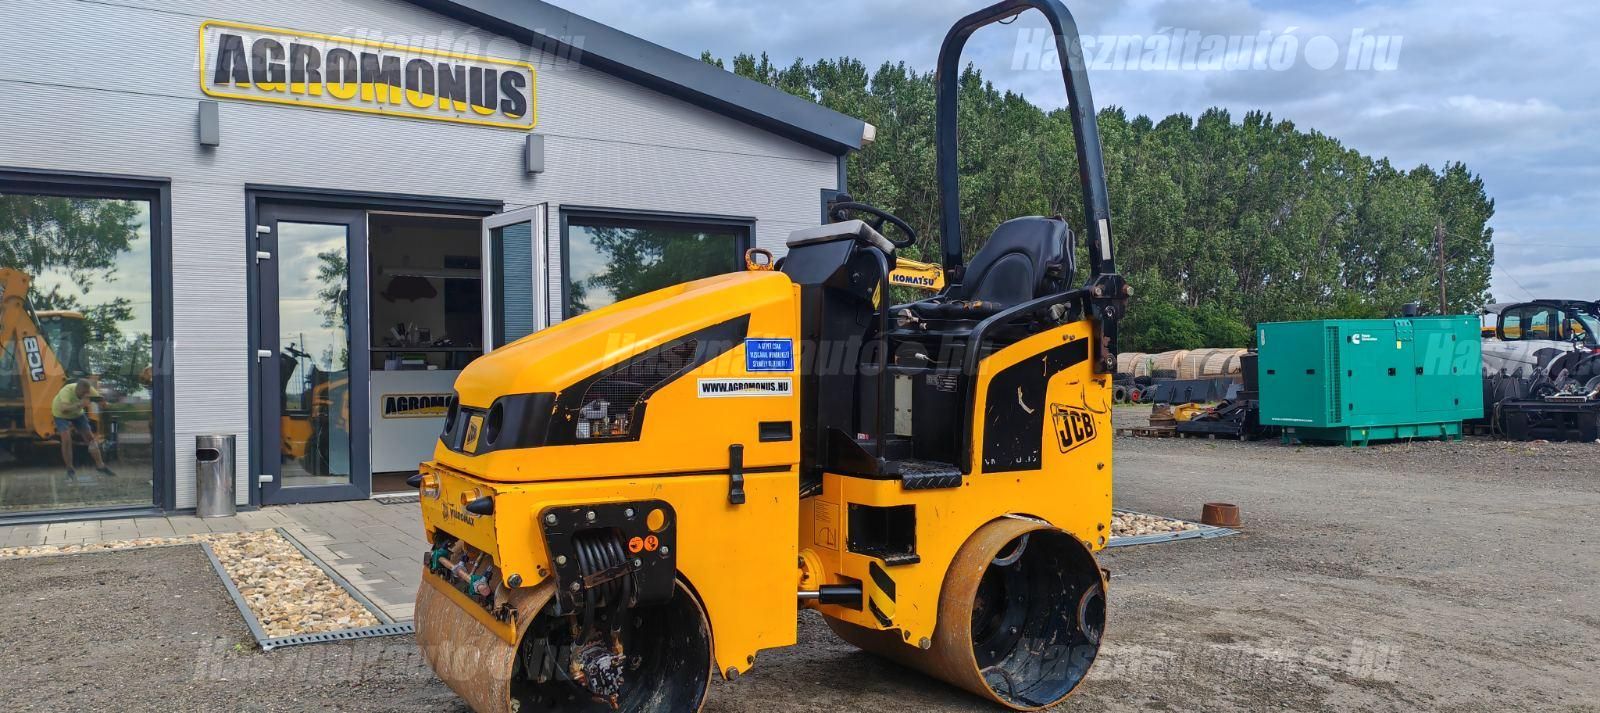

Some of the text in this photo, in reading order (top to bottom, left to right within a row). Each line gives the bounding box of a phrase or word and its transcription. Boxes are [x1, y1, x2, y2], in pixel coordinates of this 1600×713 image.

[214, 33, 528, 119] AGROMONUS
[893, 274, 934, 286] KOMATSU
[702, 382, 788, 392] WWW.AGROMONUS.HU
[1059, 407, 1094, 447] JCB
